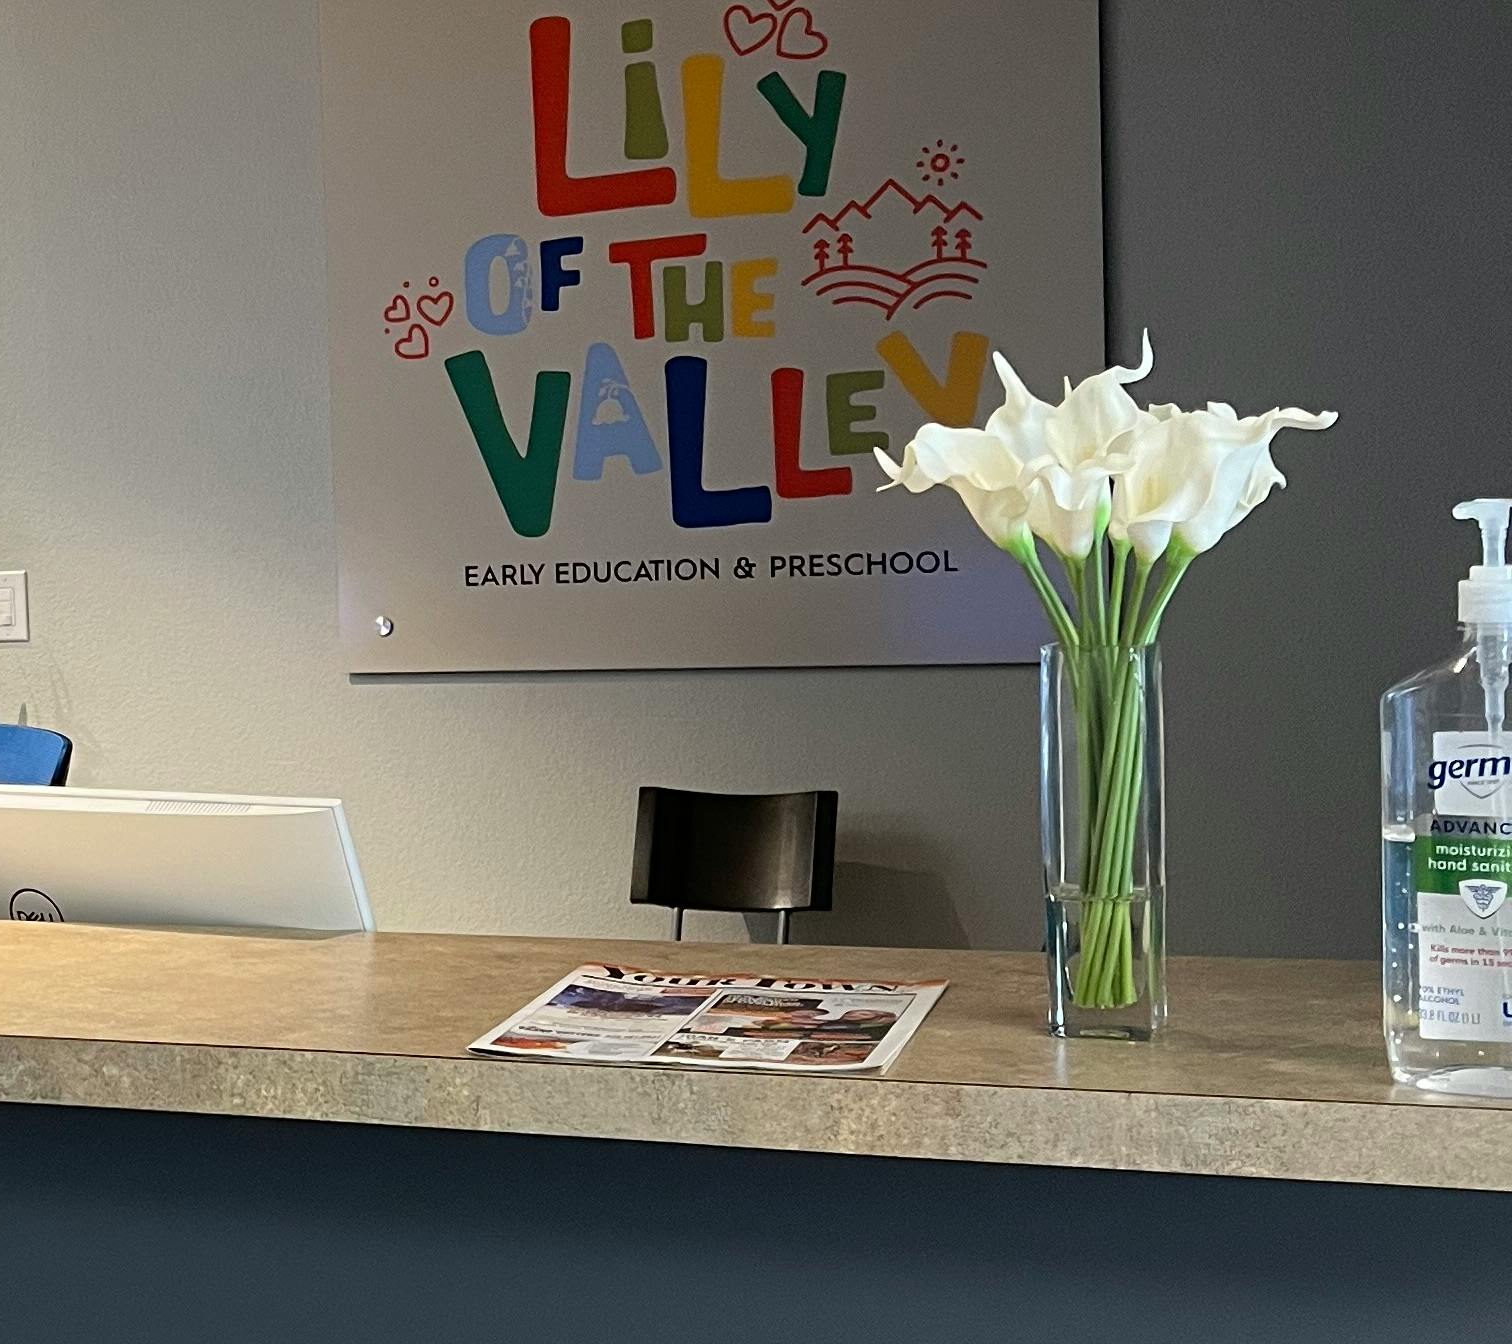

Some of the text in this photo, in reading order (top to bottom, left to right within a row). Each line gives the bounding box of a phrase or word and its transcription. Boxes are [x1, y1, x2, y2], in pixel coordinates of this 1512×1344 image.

[464, 233, 778, 343] OF THE
[464, 550, 959, 587] EARLY EDUCATION & PRESCHOOL
[1428, 857, 1467, 871] hand
[1422, 924, 1446, 933] with
[1449, 924, 1475, 936] Aloe
[1478, 926, 1487, 936] &
[1470, 958, 1480, 966] in
